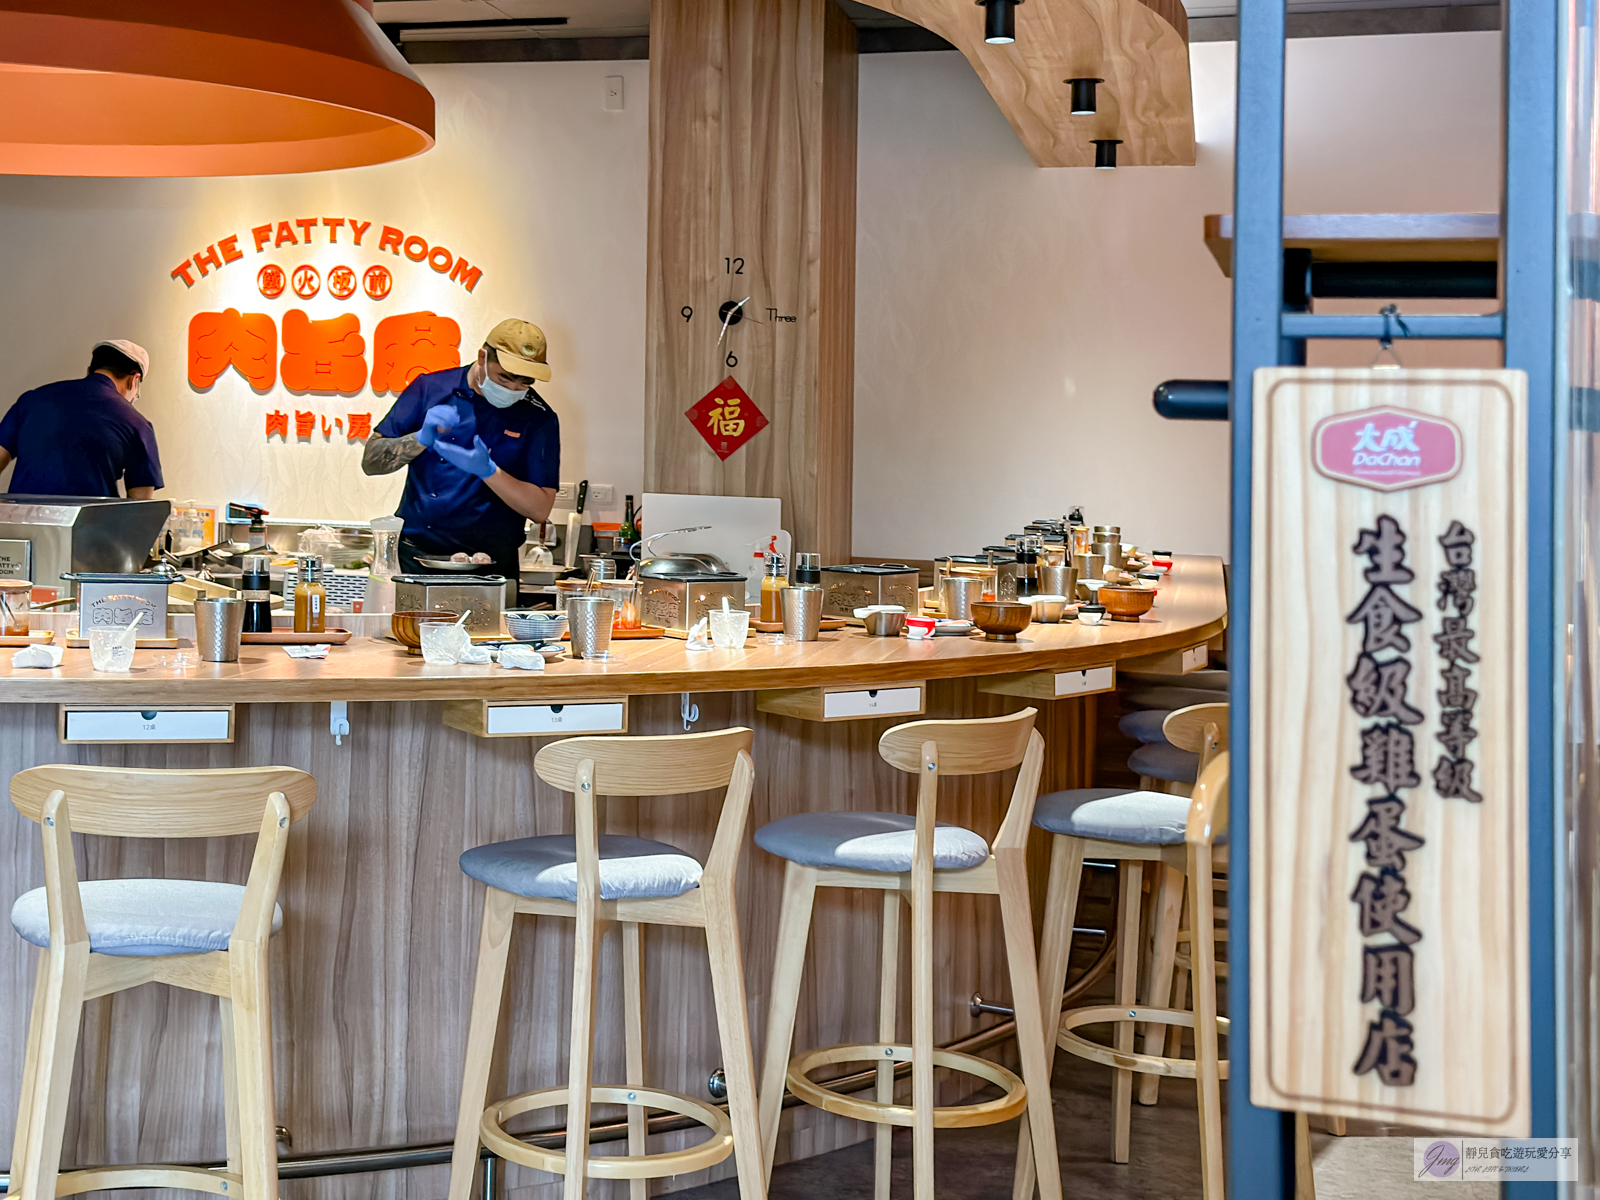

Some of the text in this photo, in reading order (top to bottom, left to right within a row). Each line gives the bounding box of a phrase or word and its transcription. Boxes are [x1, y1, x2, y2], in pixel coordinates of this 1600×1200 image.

[171, 217, 483, 292] THE FATTY ROOM
[725, 257, 745, 275] 12
[681, 306, 693, 322] 9
[765, 308, 797, 323] Three
[726, 351, 738, 367] 6
[265, 409, 372, 440] 肉旨い房
[707, 397, 745, 437] 福
[1352, 420, 1420, 452] 大成
[1352, 452, 1421, 467] DaChan
[1433, 519, 1483, 803] 台灣最高等級
